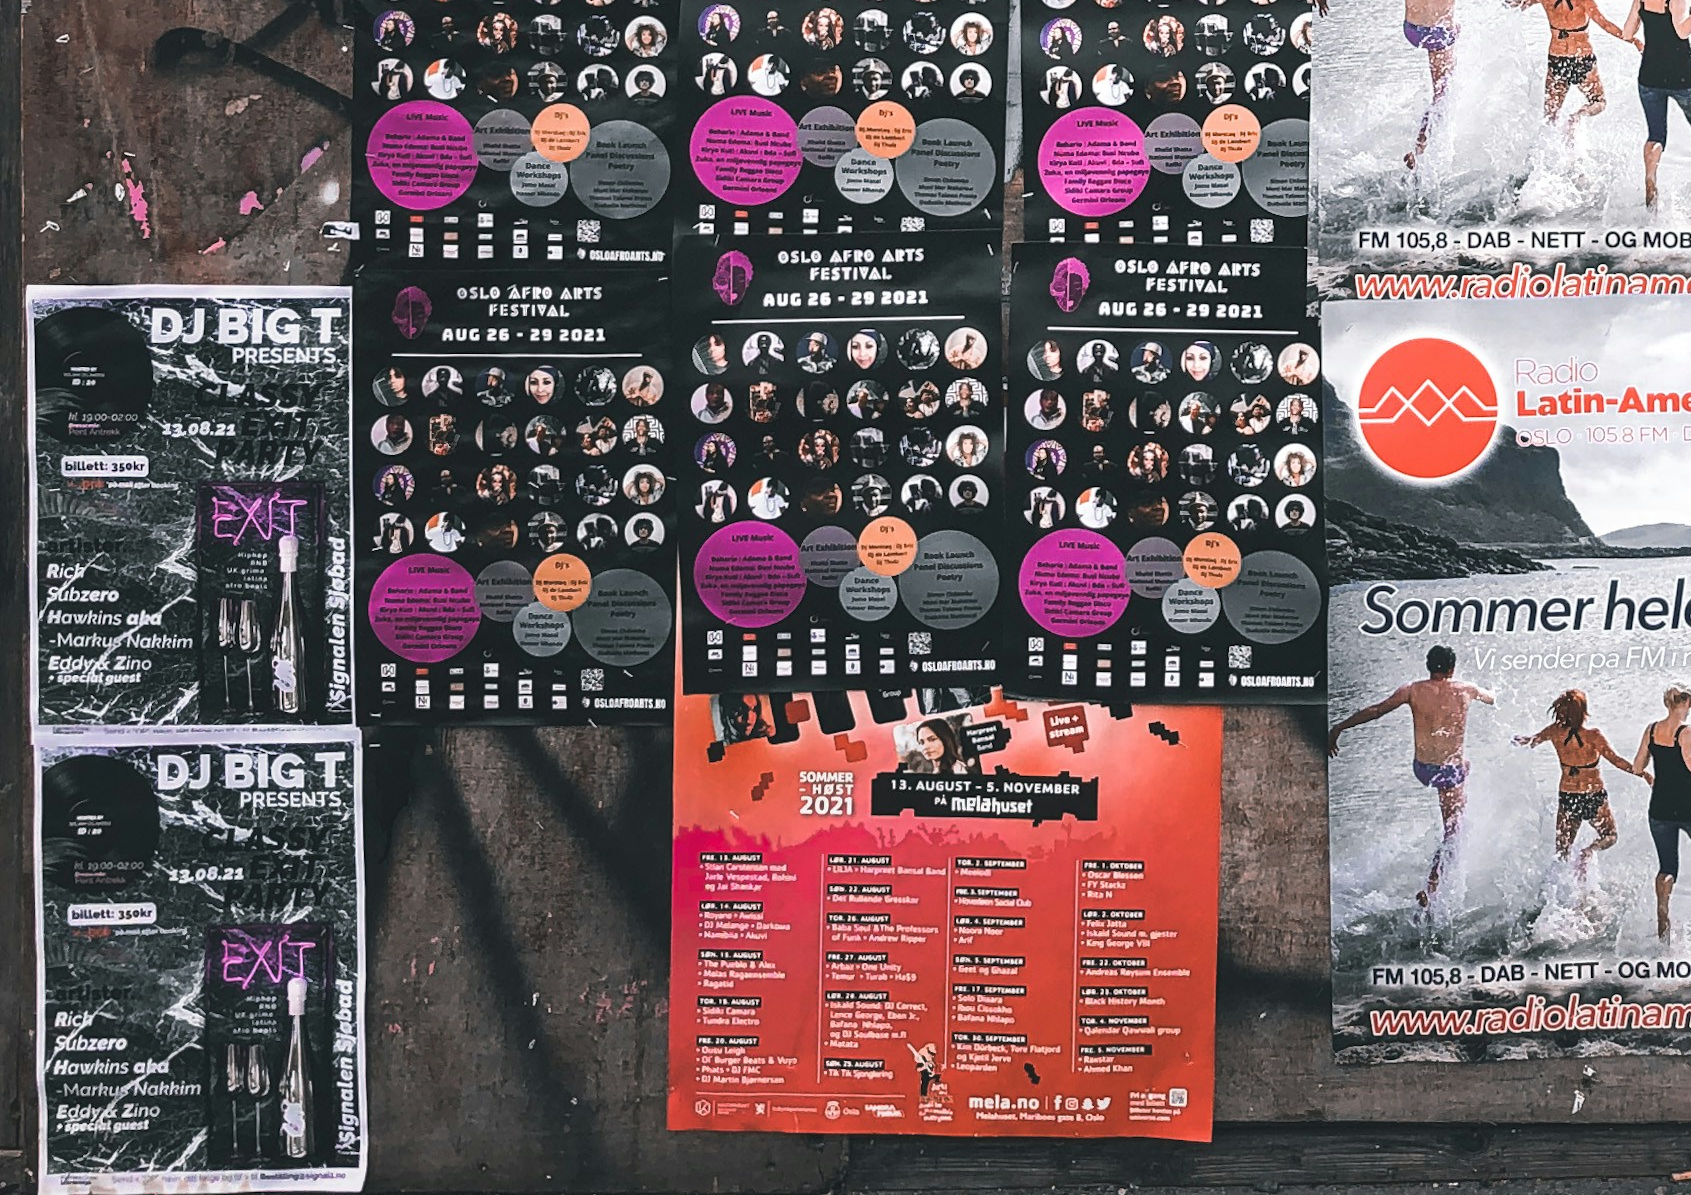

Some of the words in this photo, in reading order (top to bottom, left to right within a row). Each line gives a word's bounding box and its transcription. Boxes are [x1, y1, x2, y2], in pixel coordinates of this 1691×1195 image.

[777, 250, 822, 264] OSLO
[829, 249, 875, 263] AFRO
[881, 248, 925, 262] ARTS
[810, 267, 892, 281] FESTIVAL
[922, 659, 996, 672] OSLOAFROARTS.NO
[1050, 716, 1070, 727] Live
[1049, 725, 1085, 739] stream
[157, 754, 211, 790] DJ
[225, 753, 305, 789] BIG
[314, 751, 346, 788] T
[799, 771, 854, 783] SOMMER
[811, 783, 854, 796] HØST
[890, 780, 912, 792] 13.
[915, 781, 971, 793] AUGUST
[987, 781, 1000, 793] 5.
[1003, 782, 1080, 795] NOVEMBER
[799, 796, 853, 816] 2021
[934, 794, 947, 805] PÅ
[951, 795, 1033, 816] melahuset
[168, 867, 244, 884] 13.08.21
[71, 908, 115, 920] billett:
[118, 907, 153, 921] 350kr
[861, 915, 890, 923] AUGUST
[54, 1012, 94, 1027] Rich
[55, 1036, 127, 1051] Subzero
[53, 1059, 128, 1075] Hawkins
[133, 1082, 201, 1096] Nakkim
[969, 1096, 1040, 1110] mela.no
